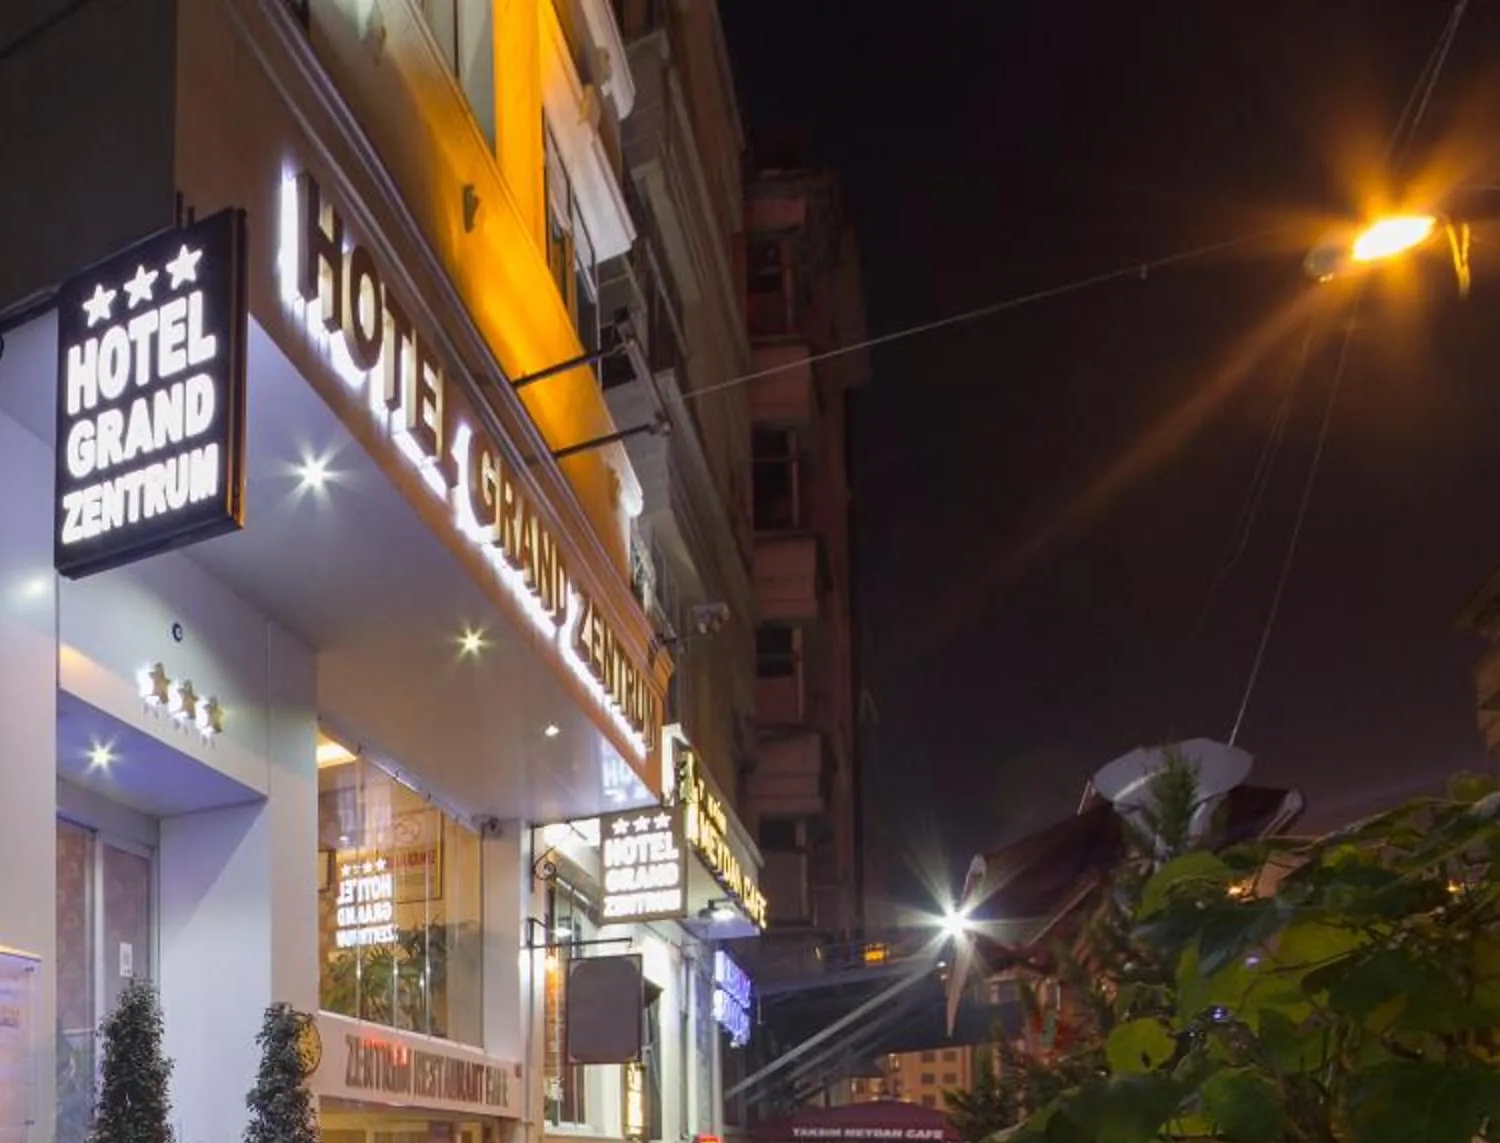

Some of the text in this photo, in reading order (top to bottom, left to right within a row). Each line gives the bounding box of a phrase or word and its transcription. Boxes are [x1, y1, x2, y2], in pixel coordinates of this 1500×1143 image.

[67, 290, 217, 415] HOTEL
[283, 160, 460, 490] HOTEL
[66, 373, 216, 478] GRAND
[61, 442, 220, 545] ZENTRUM
[604, 831, 679, 867] HOTEL
[345, 1033, 413, 1095] ZENTRUM
[844, 1128, 903, 1139] MEYDAN
[904, 1129, 944, 1140] CAFE
